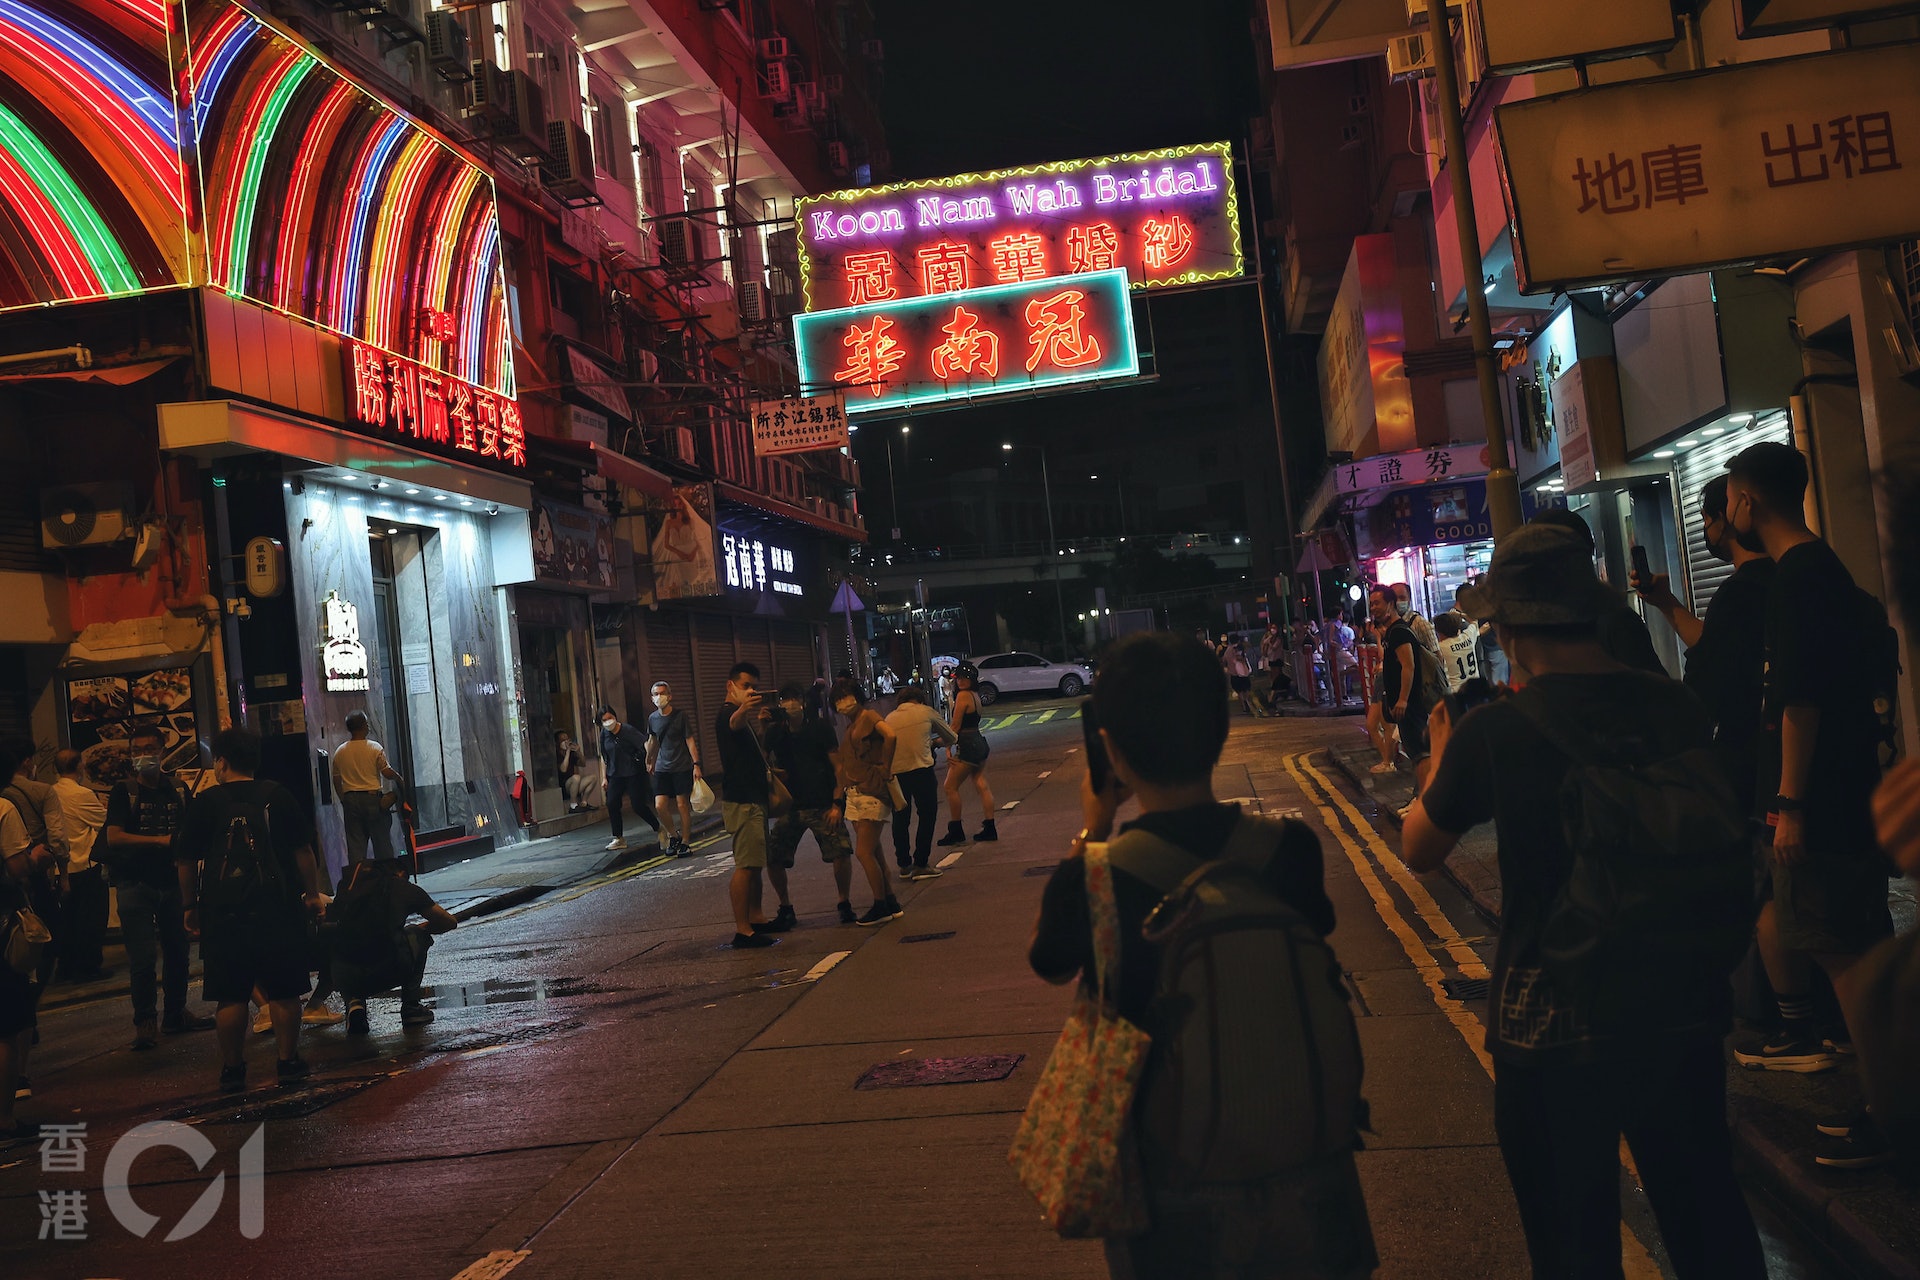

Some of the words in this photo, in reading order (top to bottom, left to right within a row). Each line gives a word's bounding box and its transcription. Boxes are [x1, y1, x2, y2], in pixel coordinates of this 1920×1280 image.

[1571, 143, 1709, 215] 地庫
[1760, 110, 1903, 188] 出租
[810, 205, 905, 241] Koon
[917, 194, 996, 228] Nam
[1006, 180, 1082, 216] Wah
[1093, 161, 1218, 206] Bridal
[844, 214, 1194, 305] 冠南華婚紗
[722, 532, 767, 593] 冠南華
[1450, 637, 1473, 652] EDWIN
[1456, 651, 1477, 680] 19
